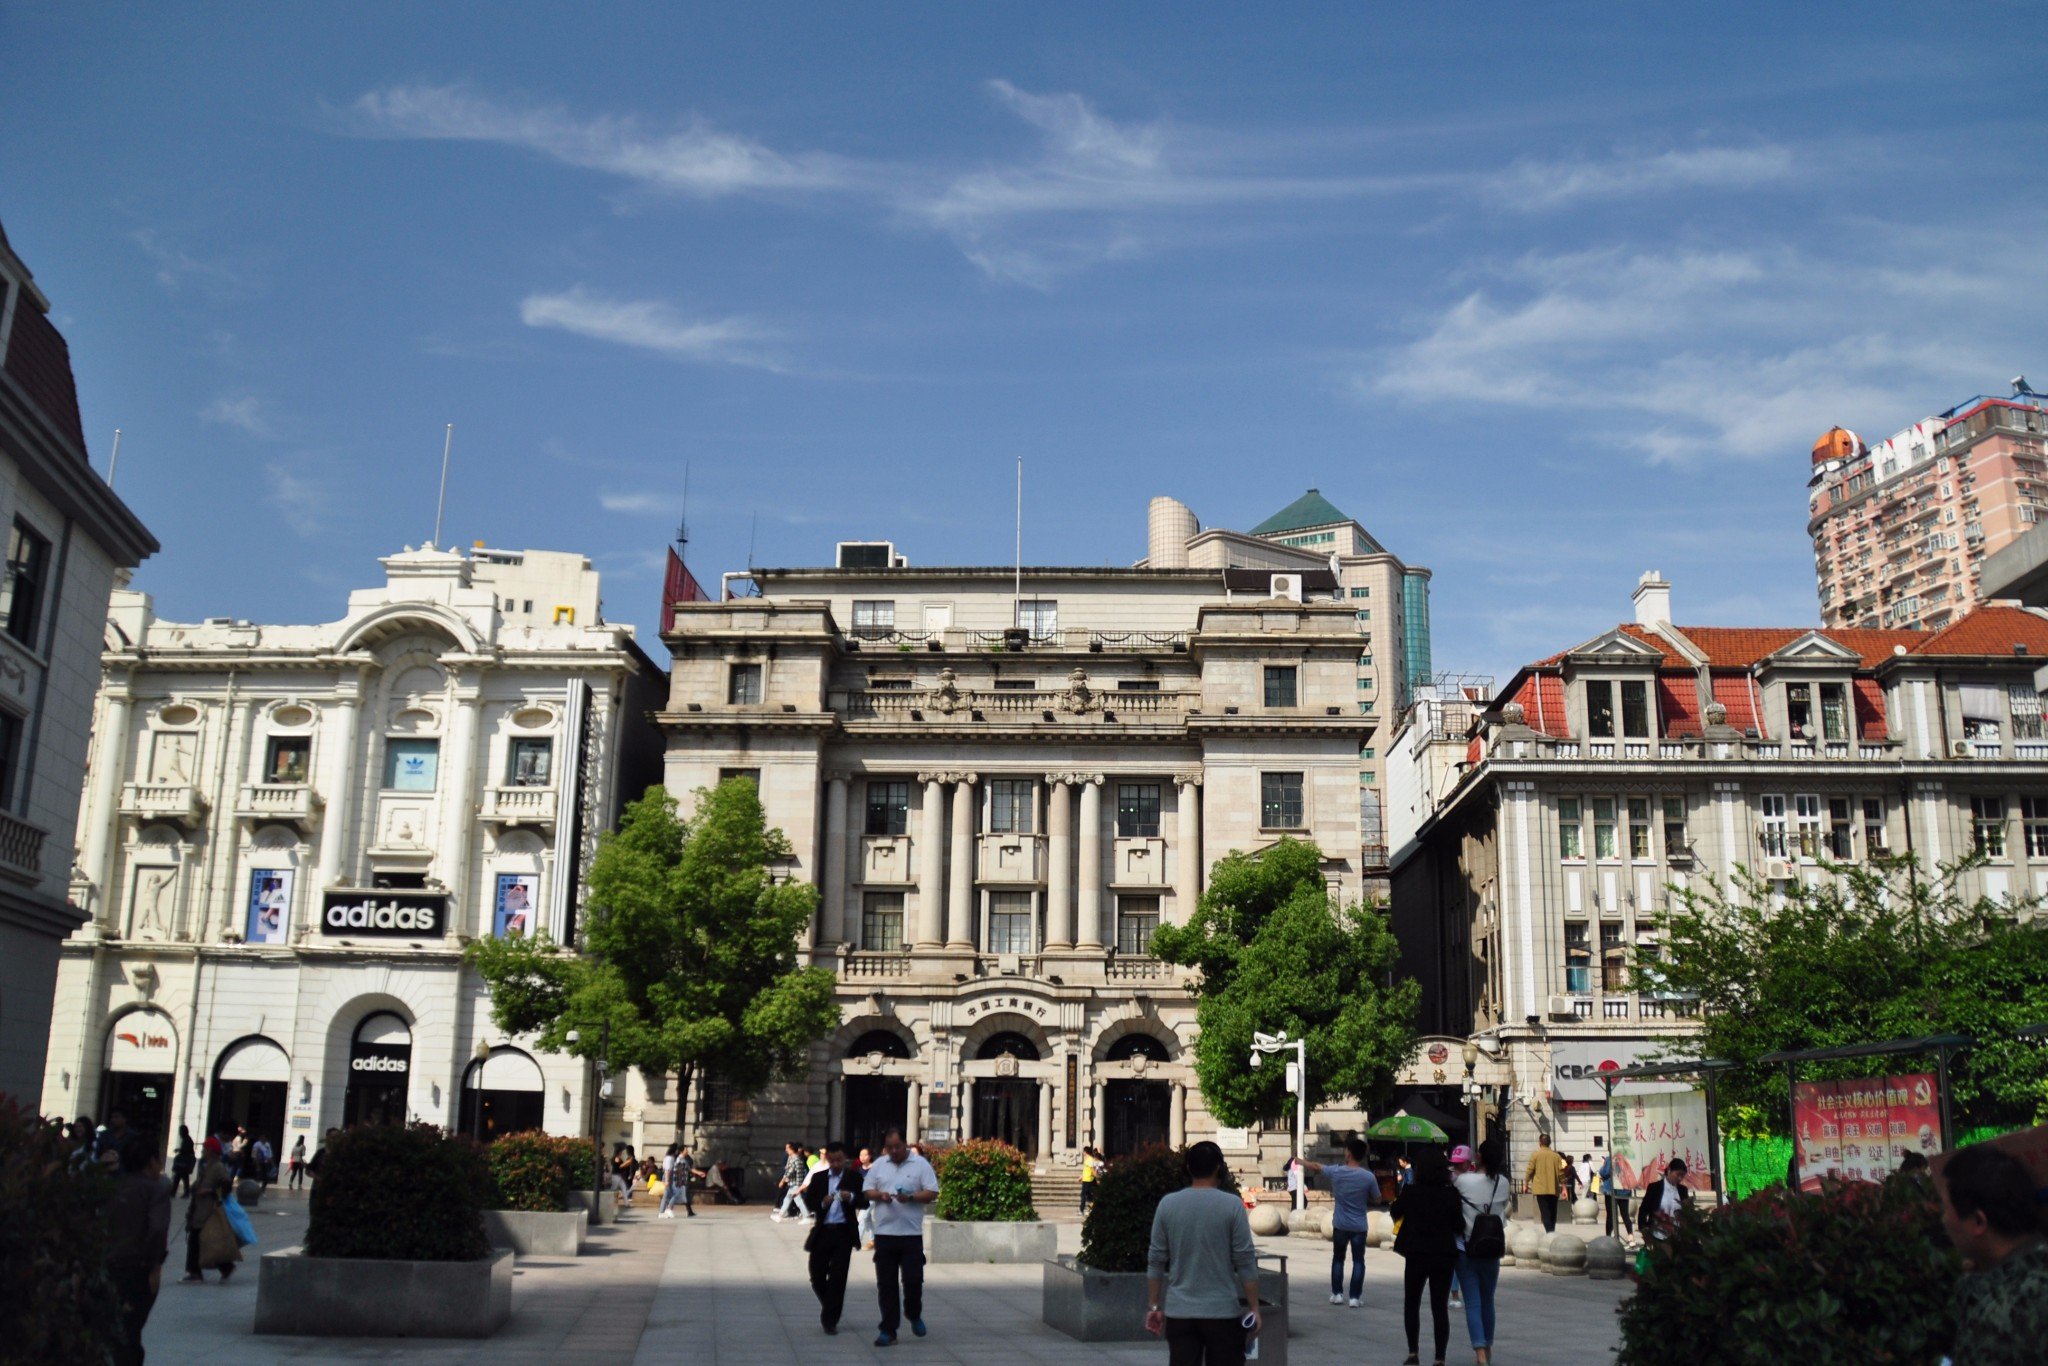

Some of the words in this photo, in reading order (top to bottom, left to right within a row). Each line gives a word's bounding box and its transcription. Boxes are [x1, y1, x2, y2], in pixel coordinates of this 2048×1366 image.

[327, 900, 434, 930] adidas
[967, 998, 1047, 1018] 中国工商银行
[352, 1055, 407, 1072] adidas
[1817, 1088, 1909, 1111] 社会主义核心价值观
[1844, 1124, 1860, 1137] 民主
[1866, 1122, 1882, 1136] 文明
[1825, 1146, 1839, 1158] 自由
[1868, 1145, 1884, 1158] 公正
